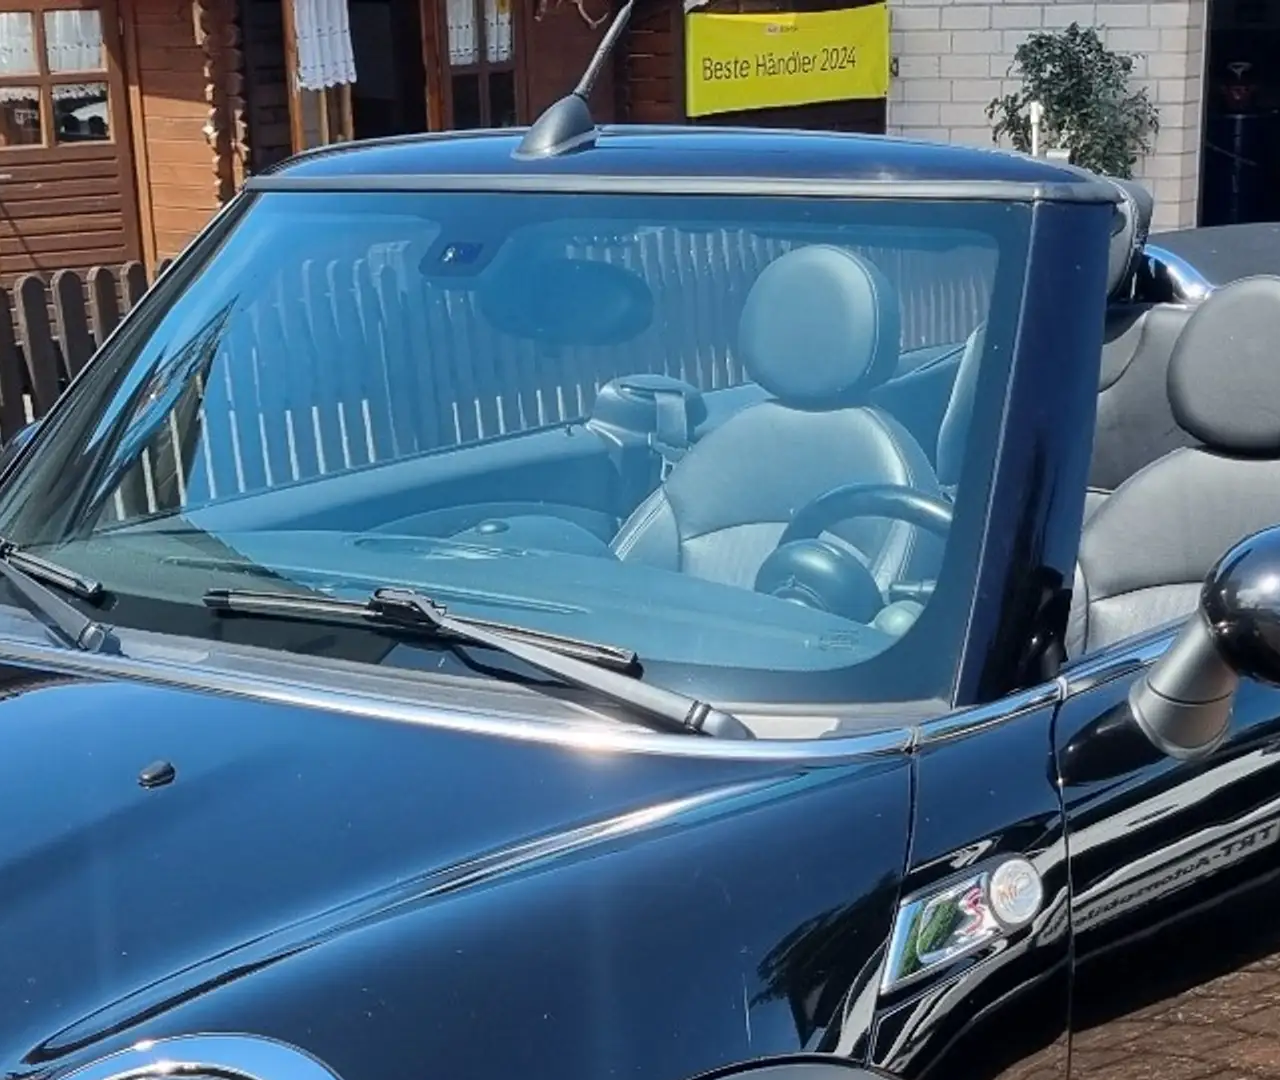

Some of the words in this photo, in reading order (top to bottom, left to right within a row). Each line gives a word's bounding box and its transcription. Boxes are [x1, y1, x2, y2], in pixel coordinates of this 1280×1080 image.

[702, 55, 749, 81] Beste
[755, 51, 818, 76] Händler
[819, 46, 856, 71] 2024
